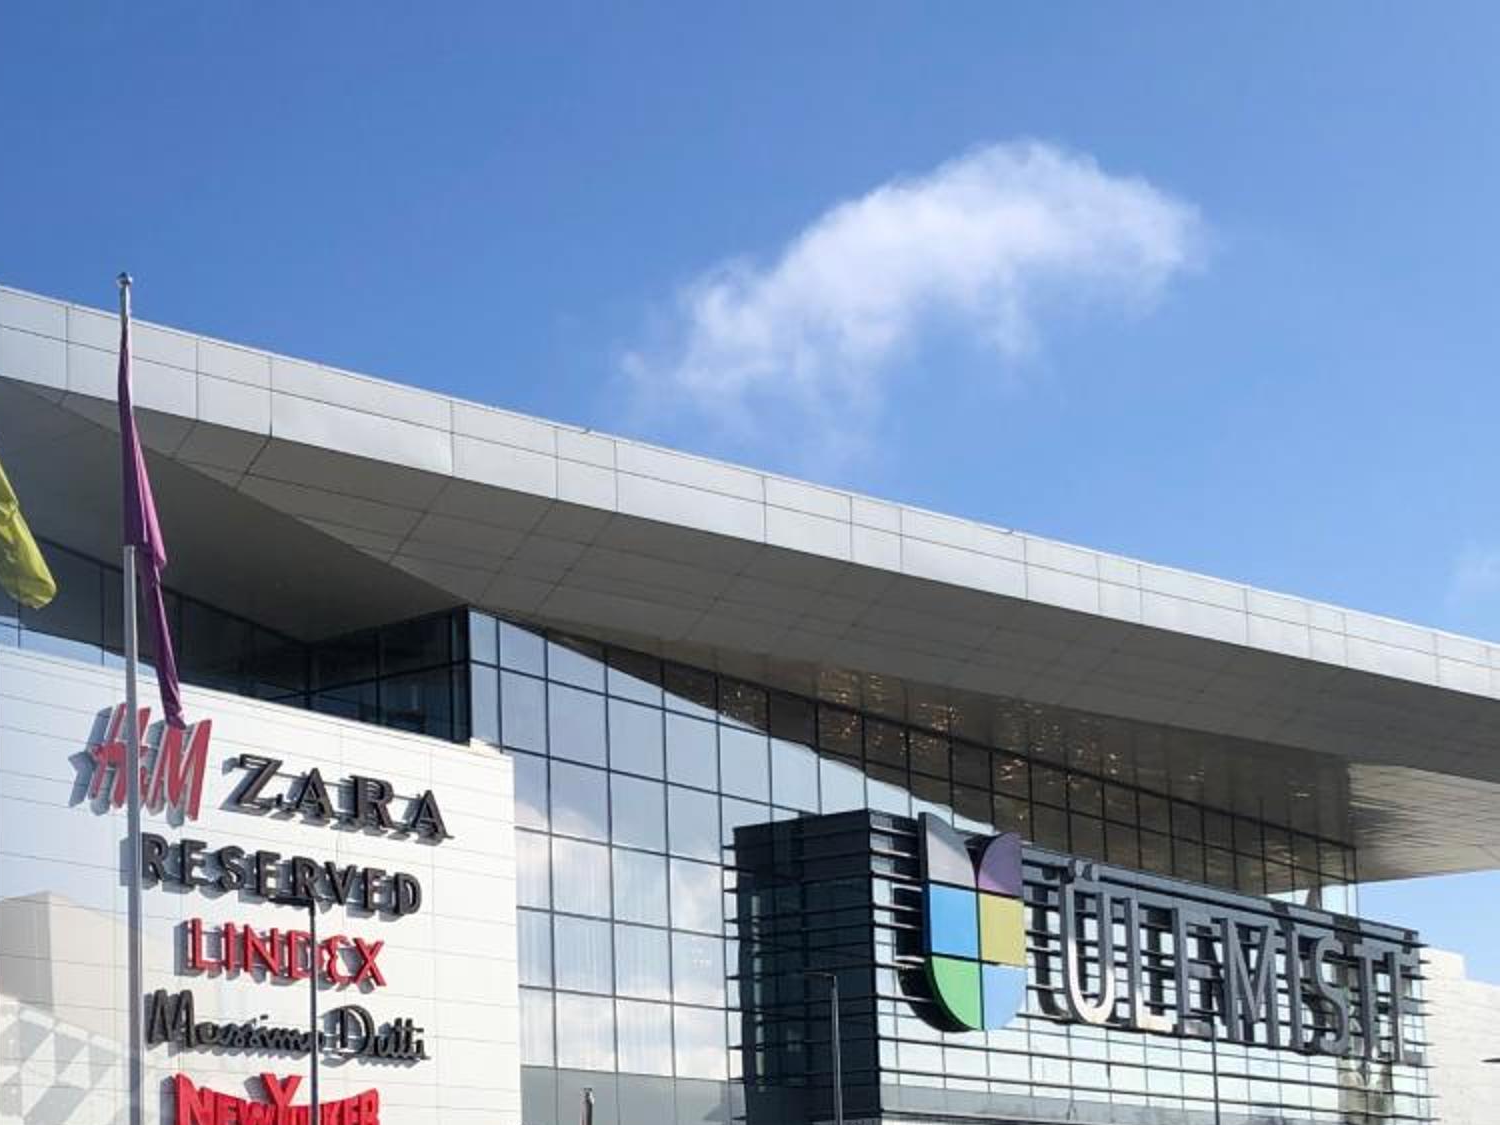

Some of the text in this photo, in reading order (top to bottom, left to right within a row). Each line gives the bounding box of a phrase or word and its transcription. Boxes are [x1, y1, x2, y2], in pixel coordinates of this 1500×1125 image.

[238, 753, 455, 842] ZARA
[141, 832, 422, 915] RESERVED
[187, 918, 386, 987] LINDEX
